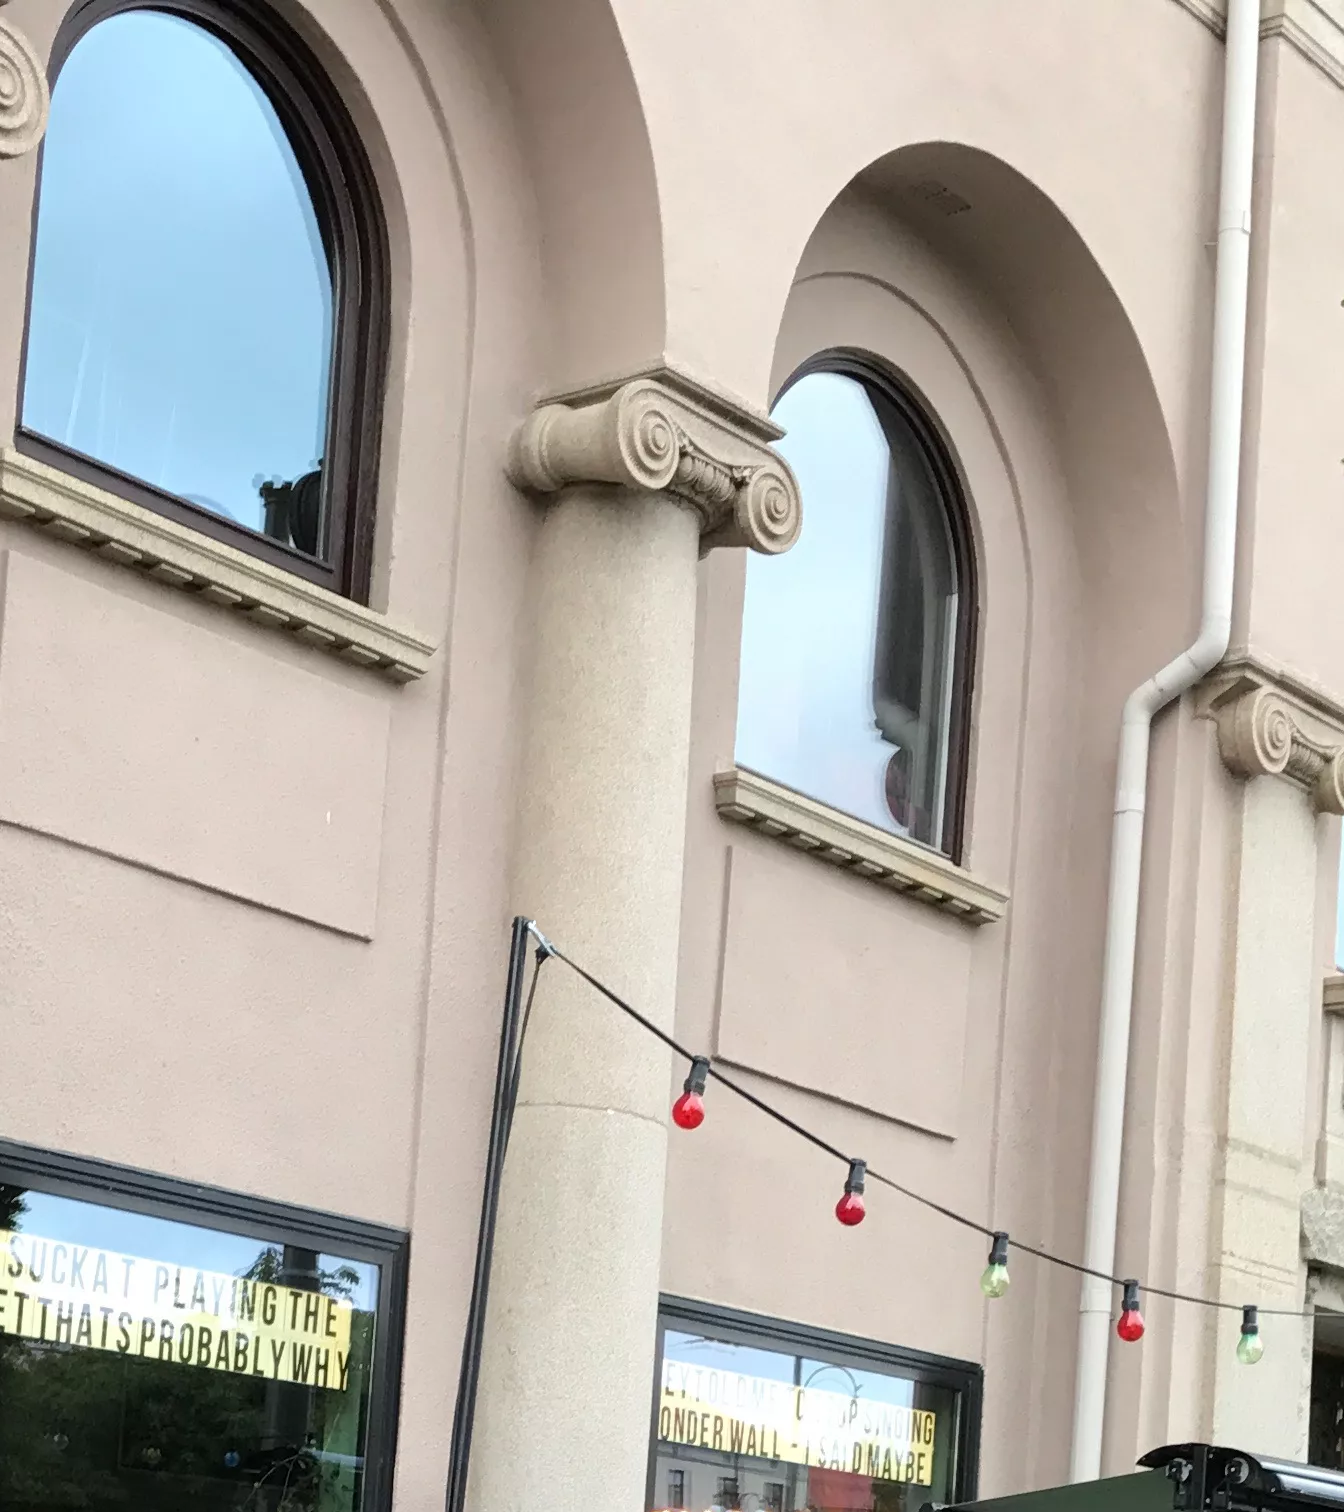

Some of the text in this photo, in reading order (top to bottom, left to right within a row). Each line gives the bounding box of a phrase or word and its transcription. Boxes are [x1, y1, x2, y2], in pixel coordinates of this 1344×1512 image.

[37, 1297, 133, 1352] THATS
[140, 1317, 285, 1380] PROBABLY
[292, 1342, 350, 1391] WHY
[289, 1291, 338, 1337] THE
